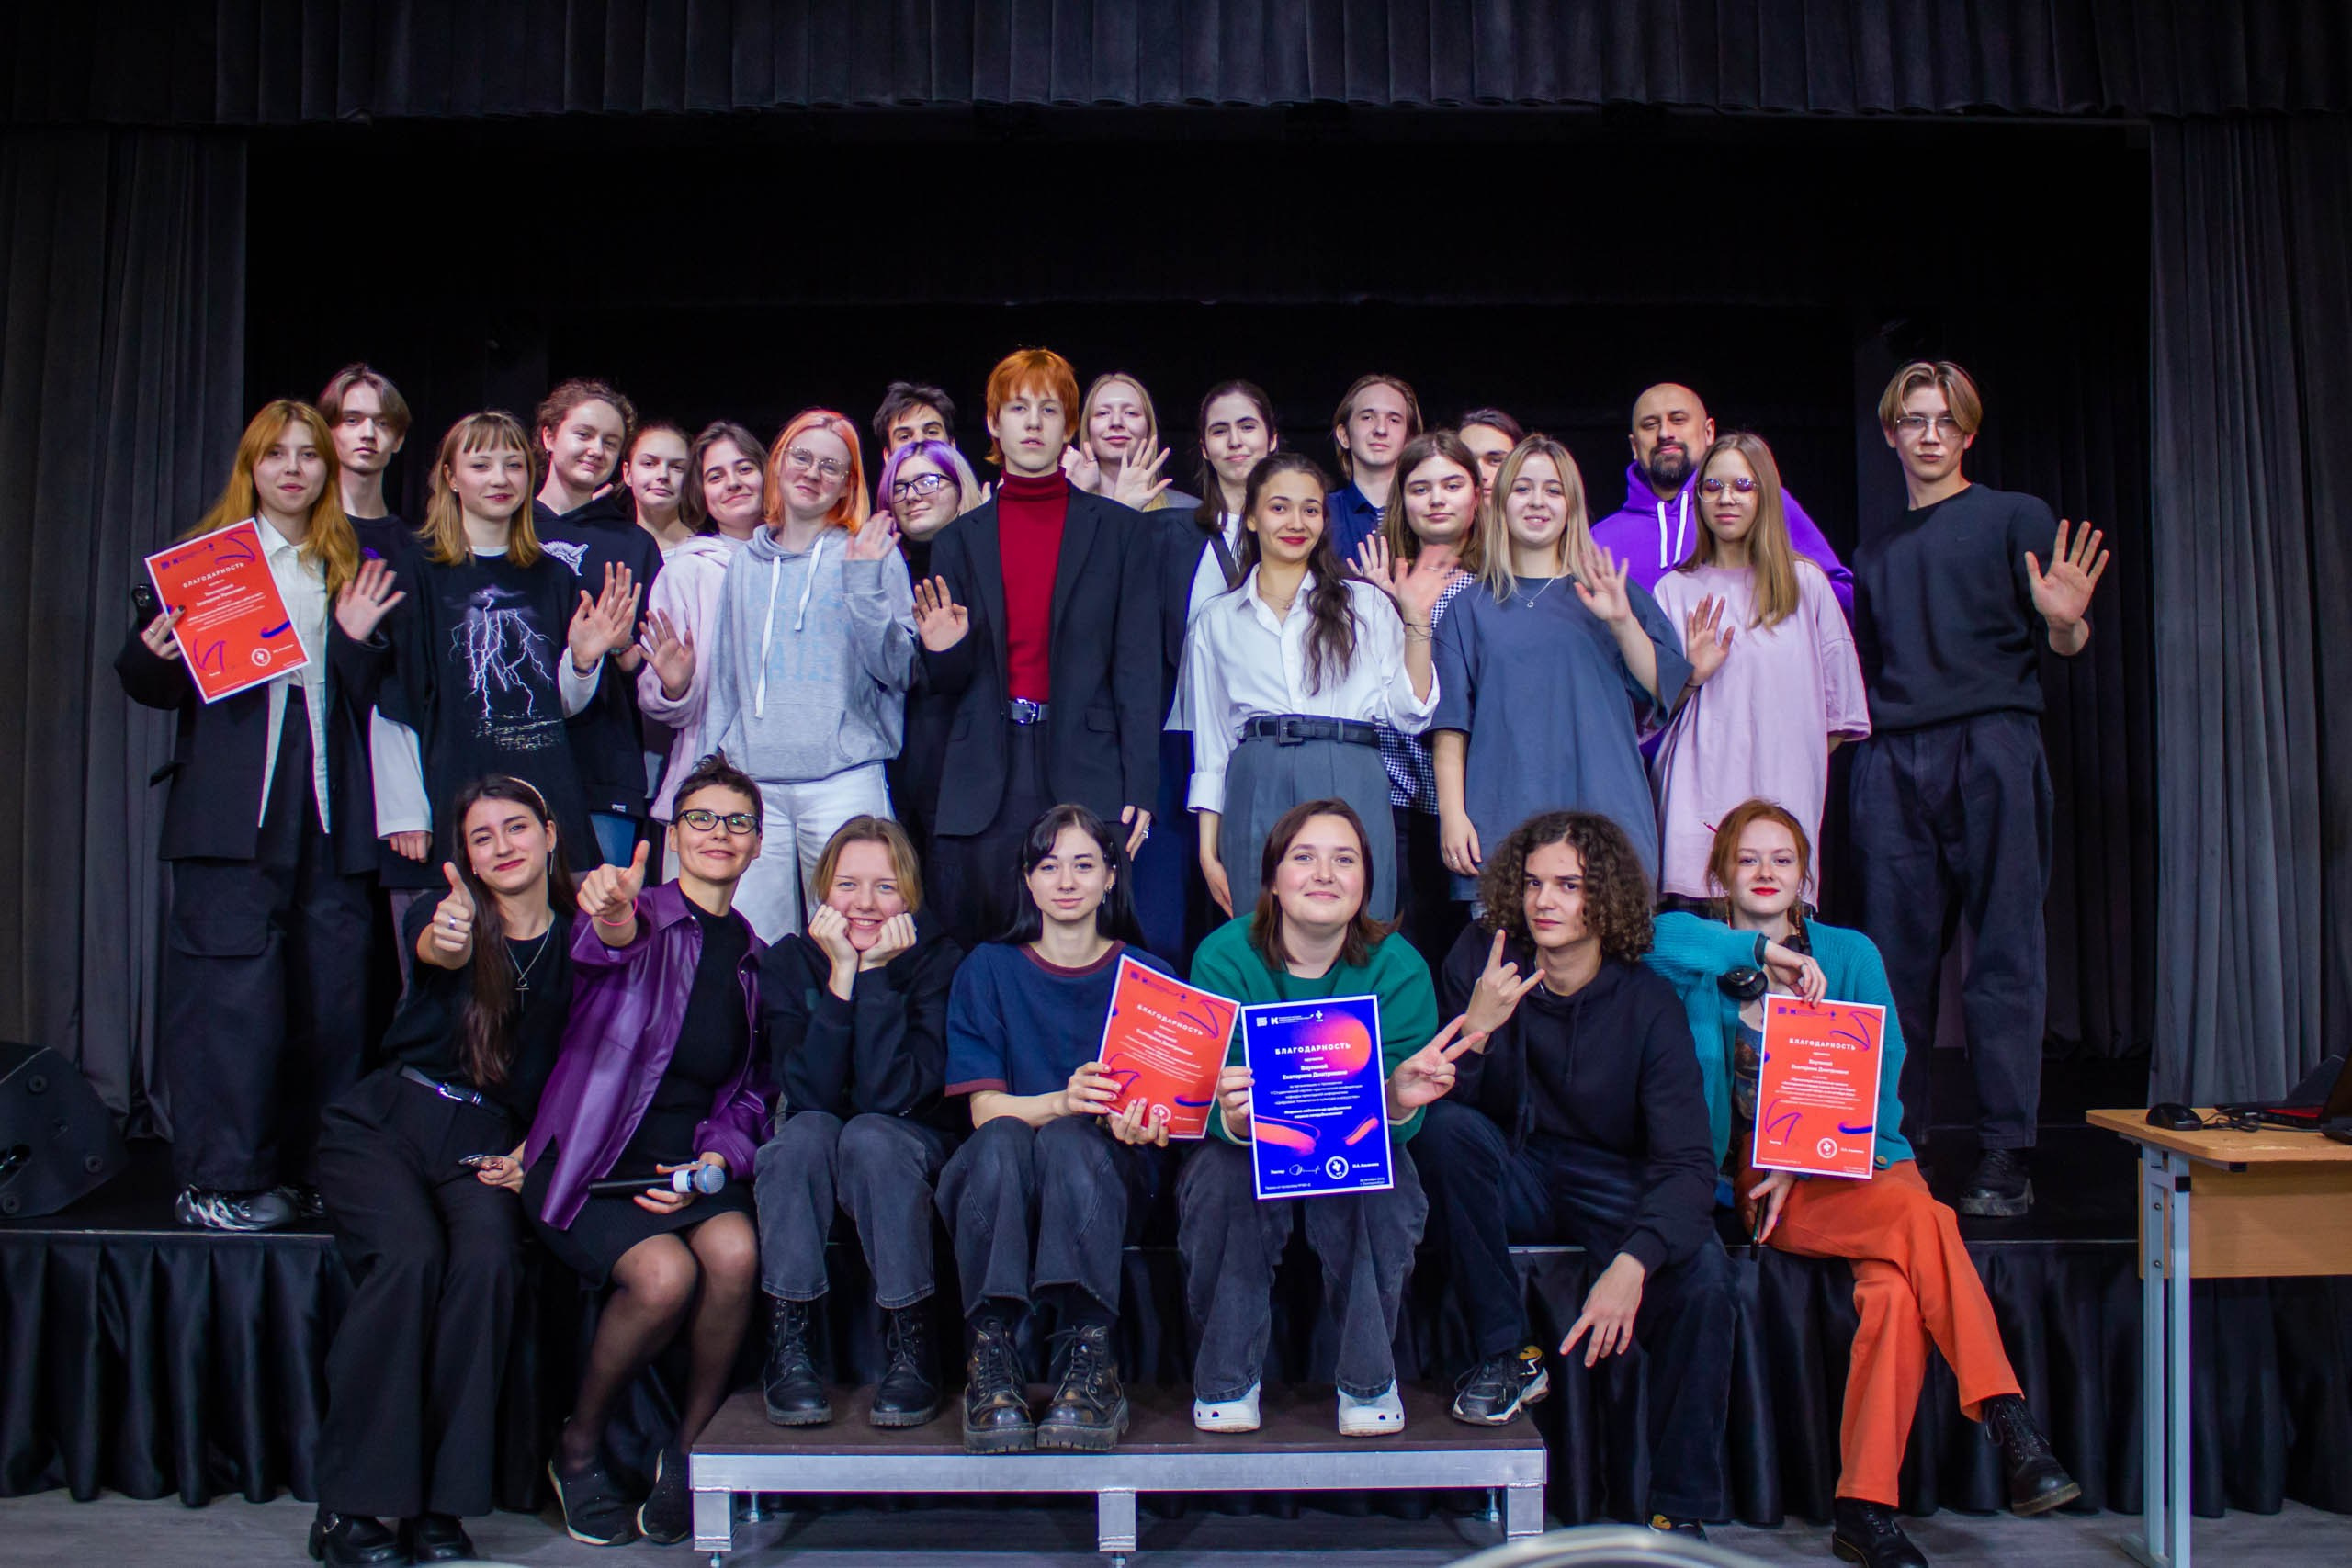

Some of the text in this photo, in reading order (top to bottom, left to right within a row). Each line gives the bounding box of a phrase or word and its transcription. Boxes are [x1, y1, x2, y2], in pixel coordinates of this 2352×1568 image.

[182, 561, 245, 589] БЛАГОДАРНОСТЬ
[1136, 1003, 1204, 1036] БЛАГОДАРНОСТЬ
[1274, 1043, 1351, 1055] БЛАГОДАРНОСТЬ
[1789, 1038, 1856, 1051] БЛАГОДАРНОСТЬ
